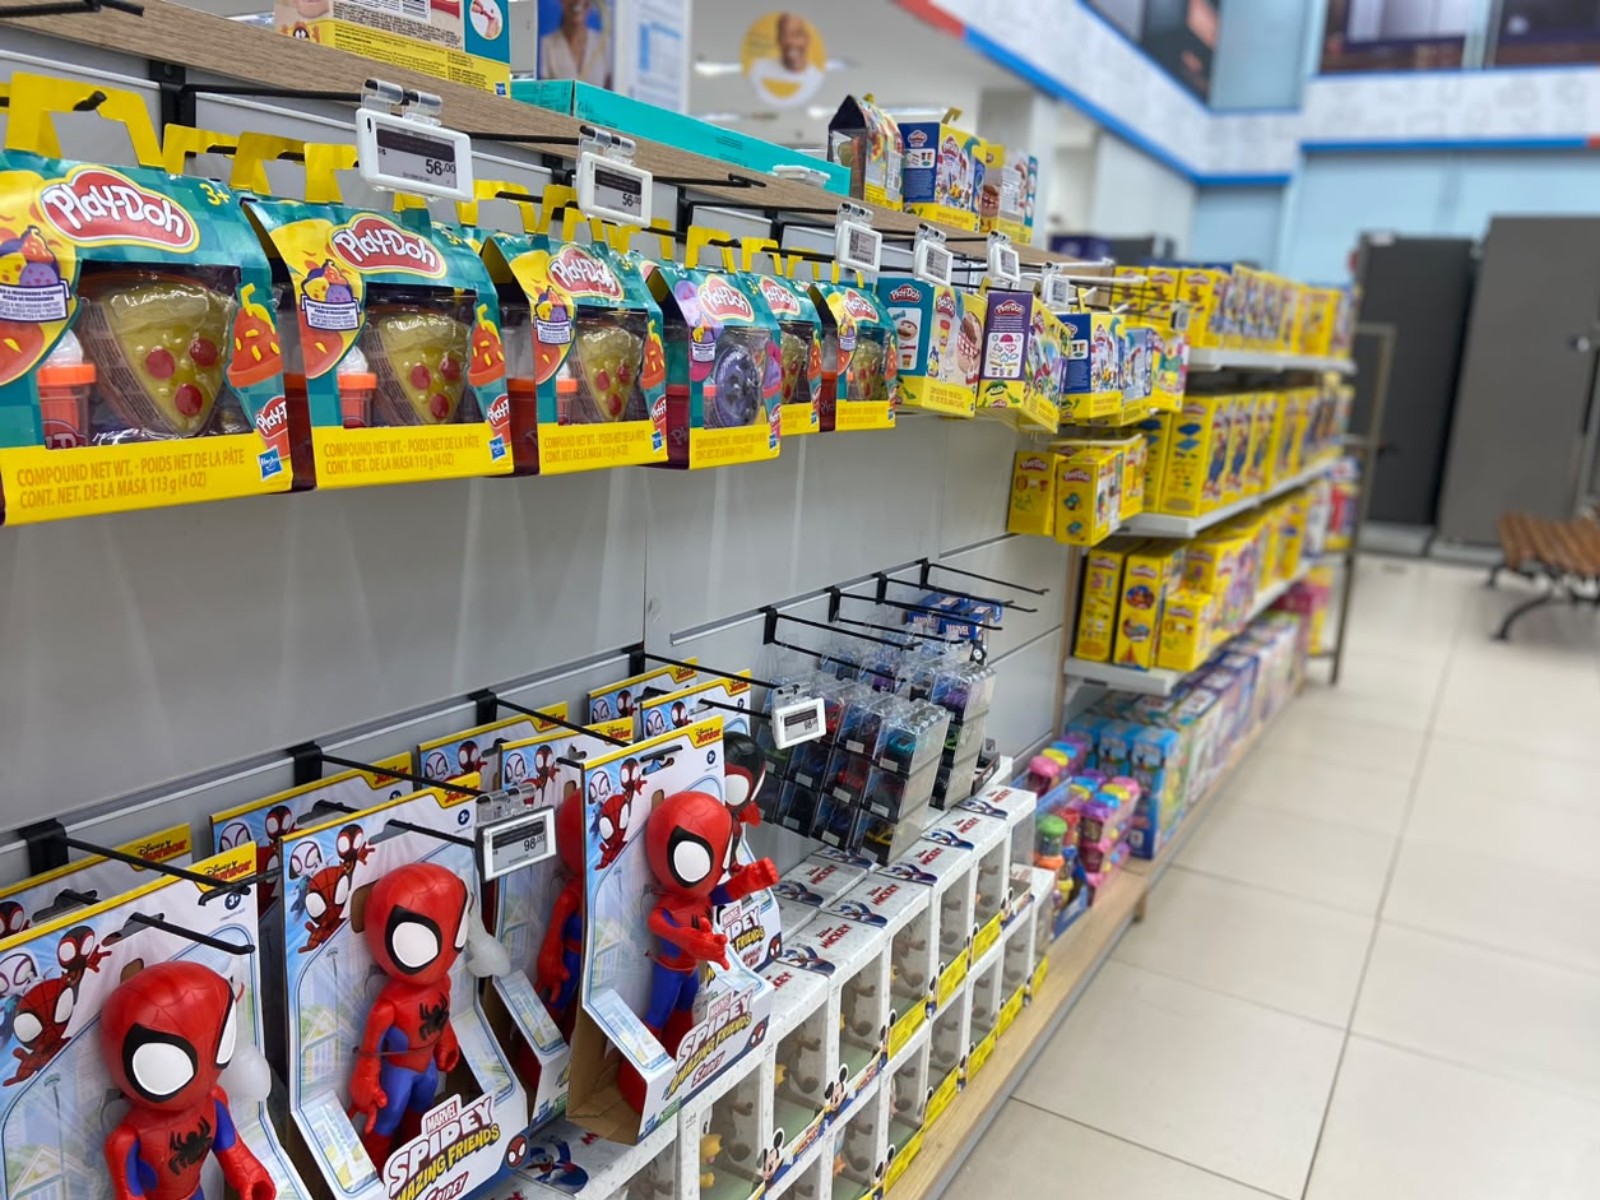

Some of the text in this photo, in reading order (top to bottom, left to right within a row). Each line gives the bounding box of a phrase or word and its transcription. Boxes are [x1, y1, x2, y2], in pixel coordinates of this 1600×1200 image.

[41, 184, 184, 238] Play-Doh
[200, 183, 230, 206] 3+
[333, 228, 436, 268] Play-Doh
[17, 463, 88, 487] COMPOUND
[91, 461, 112, 480] NET
[113, 460, 133, 477] WT.
[141, 454, 173, 474] POIDS
[174, 453, 193, 470] NET
[195, 452, 208, 468] DE
[209, 451, 222, 467] LA
[20, 489, 55, 509] CONT.
[58, 486, 81, 505] NET.
[84, 483, 99, 501] DE
[101, 481, 114, 499] LA
[117, 478, 148, 497] MASA
[151, 476, 168, 493] 113
[170, 478, 177, 494] g
[677, 988, 753, 1072] SPIDEY
[426, 1101, 458, 1133] MARVEL
[389, 1096, 492, 1198] SPIDEY
[448, 1123, 500, 1165] FRIENDS
